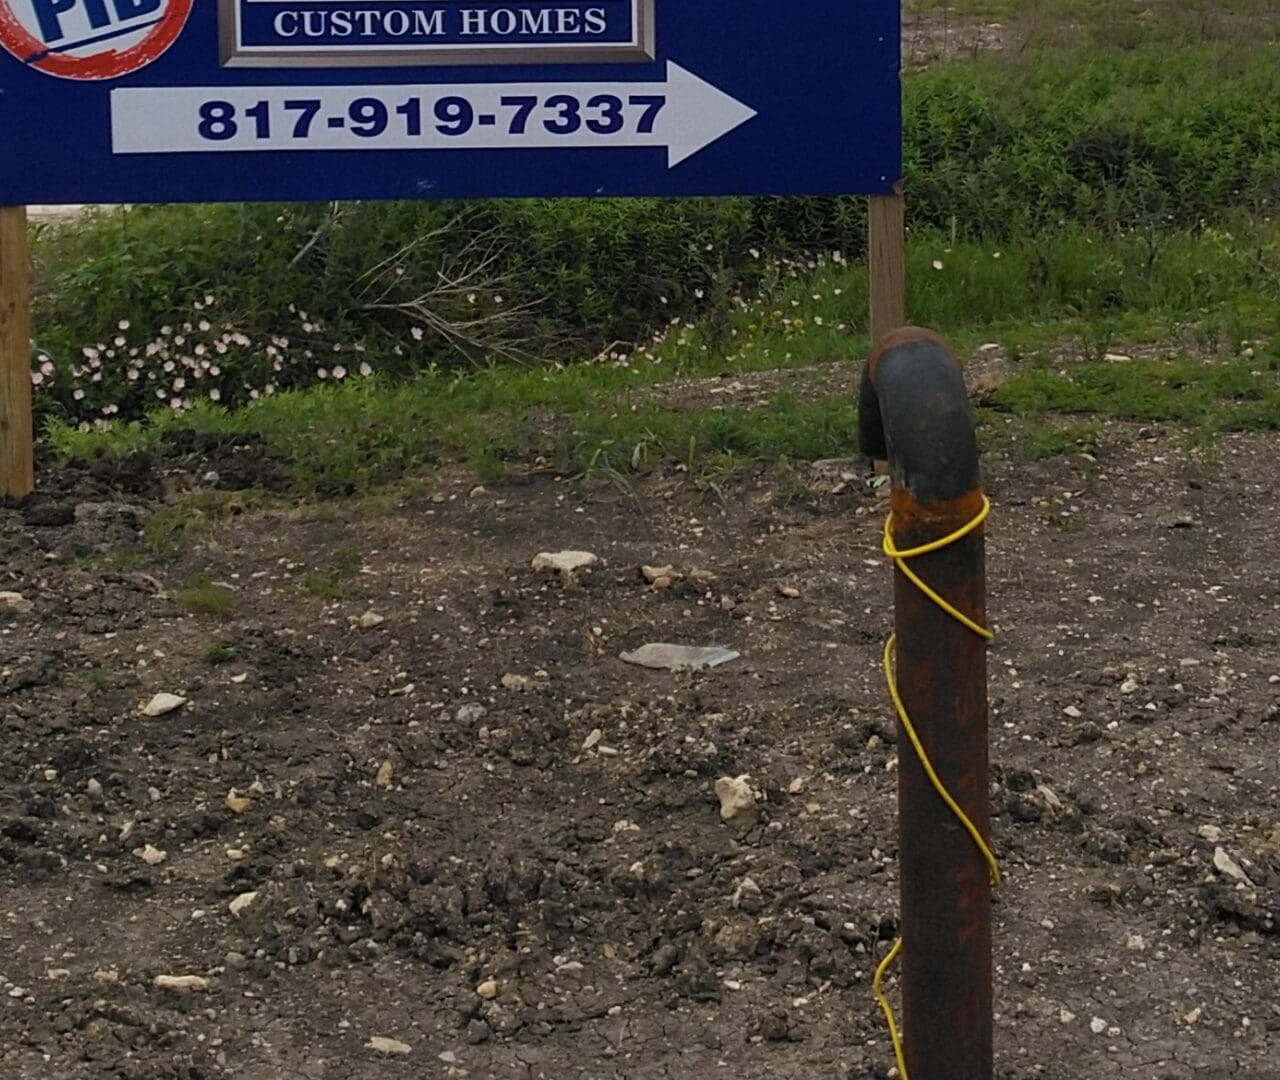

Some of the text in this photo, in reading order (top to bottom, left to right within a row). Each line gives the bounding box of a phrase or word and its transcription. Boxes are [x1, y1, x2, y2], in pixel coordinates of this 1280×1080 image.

[274, 8, 607, 37] CUSTOM HOMES
[196, 94, 666, 141] 817-919-7337
